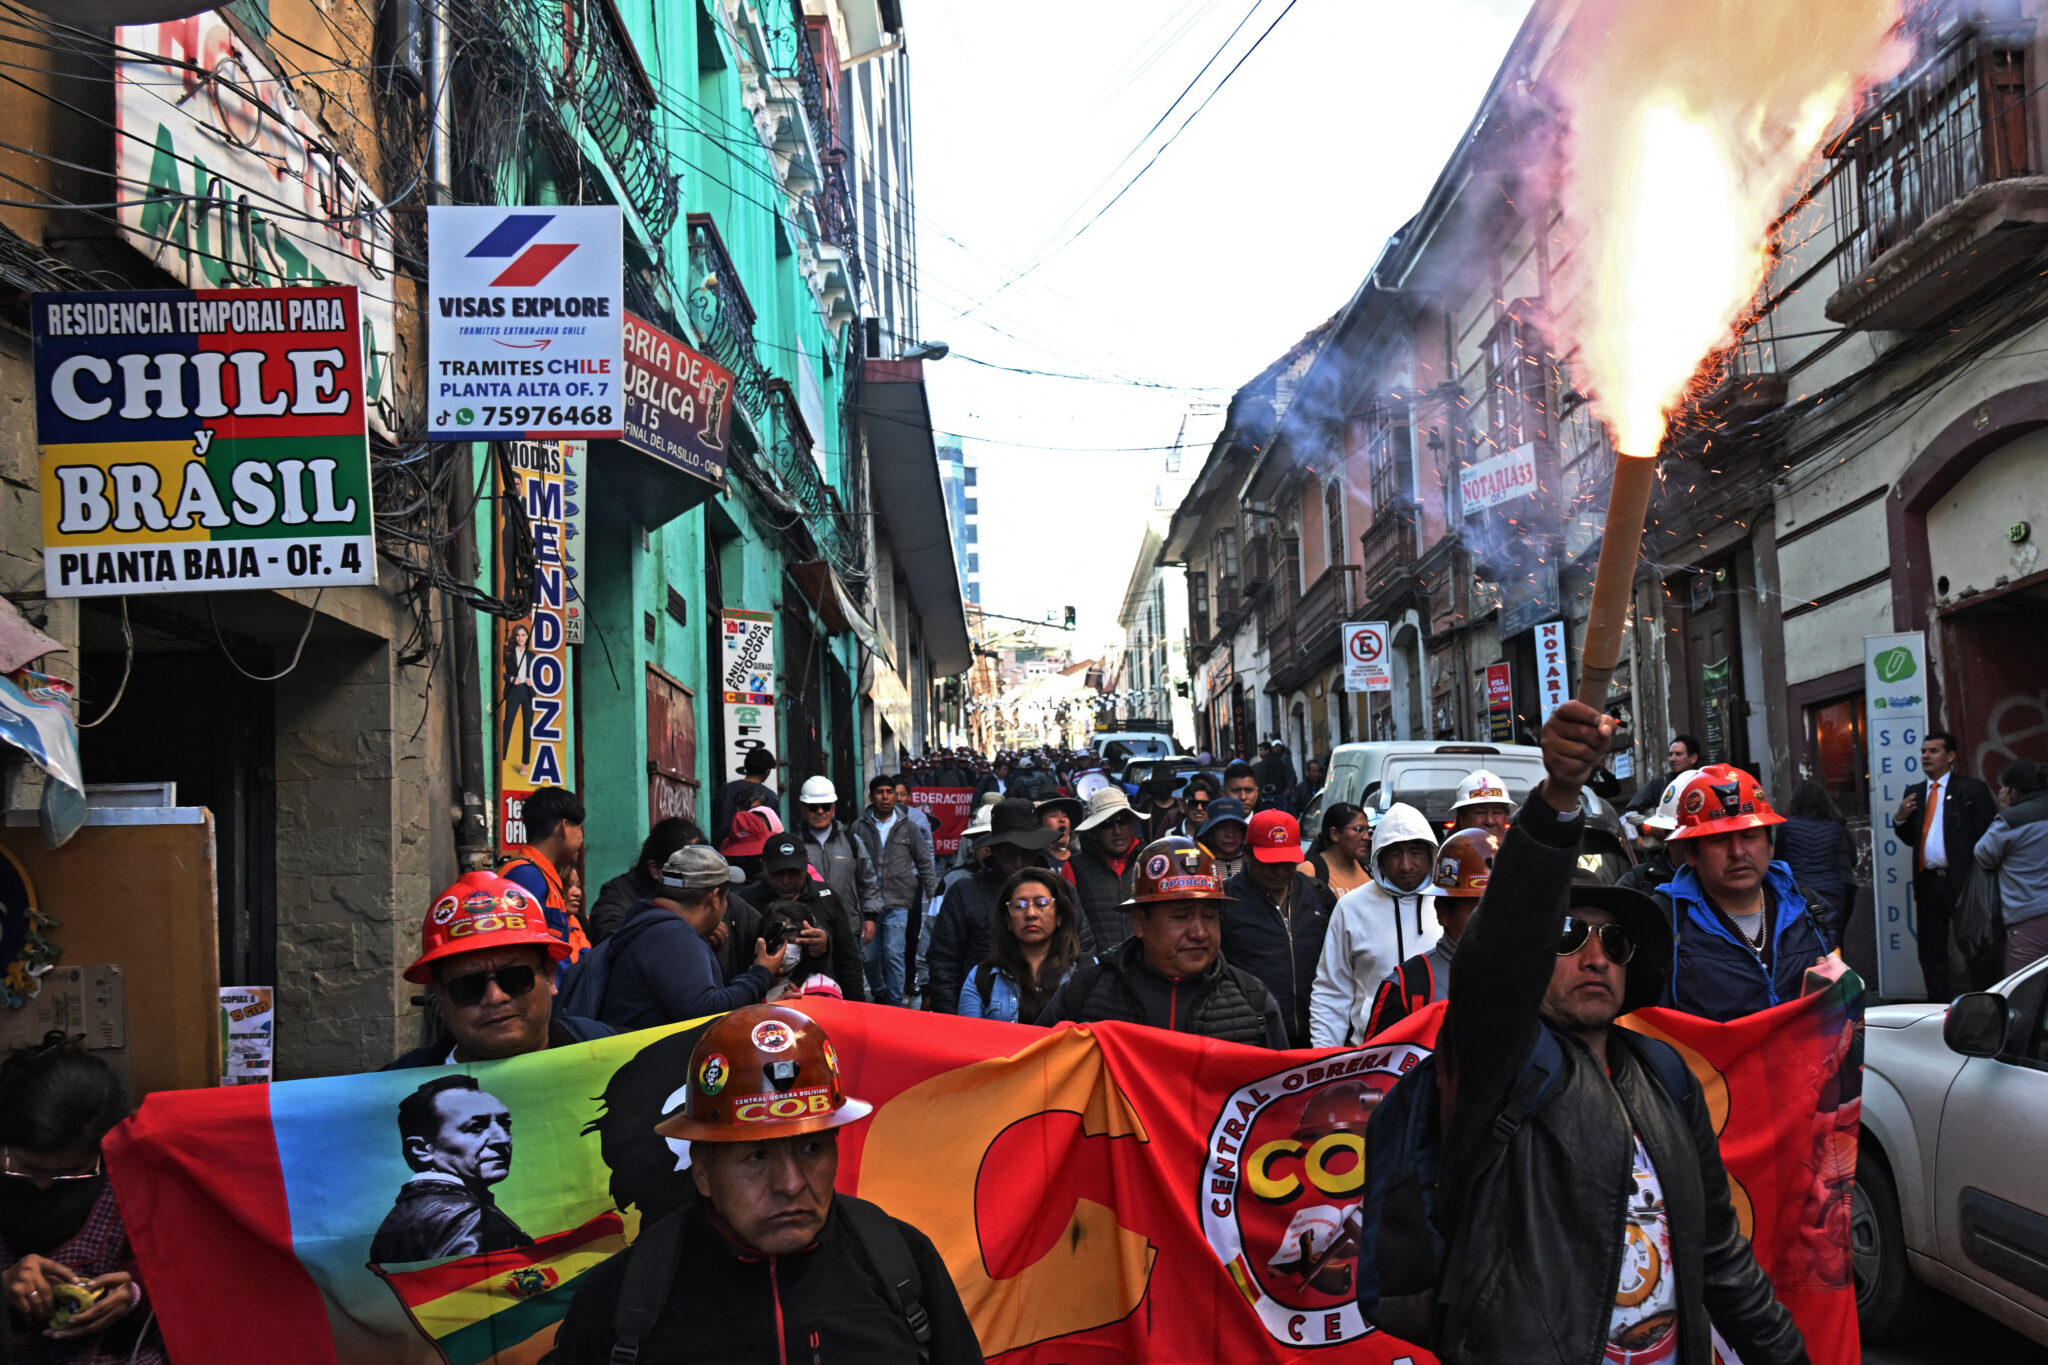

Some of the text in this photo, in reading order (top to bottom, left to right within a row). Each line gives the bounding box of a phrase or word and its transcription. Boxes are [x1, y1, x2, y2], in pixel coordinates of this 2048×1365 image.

[47, 298, 346, 336] RESIDENCIA TEMPORAL PARA
[438, 297, 610, 318] VISAS EXPLORE
[459, 326, 587, 336] TRAMITES EXTRANJERIA CHILE
[50, 348, 351, 421] CHILE
[439, 359, 611, 377] TRAMITES CHILE
[676, 350, 703, 389] DE
[440, 382, 609, 397] PLANTA ALTA OF. 7
[481, 405, 613, 426] 75976468
[641, 403, 660, 430] 15
[193, 429, 215, 455] y
[507, 441, 560, 475] MODAS
[625, 421, 648, 443] FINAL
[650, 435, 666, 451] DEL
[667, 442, 700, 467] PASILLO
[55, 457, 357, 534] BRASIL
[60, 548, 178, 586] PLANTA
[184, 546, 261, 581] BAJA
[286, 543, 332, 576] OF.
[340, 542, 362, 574] 4
[528, 478, 563, 785] MENDOZA
[725, 623, 762, 687] ANILLADOS
[731, 625, 773, 691] FOTOCOPIA
[1541, 624, 1561, 708] NOTARI
[725, 692, 774, 705] COLOR
[912, 791, 973, 804] EDERACION
[1880, 729, 1898, 884] SELLOS
[450, 915, 528, 937] COB
[221, 995, 256, 1004] COPIAS A
[735, 1096, 767, 1105] CENTRAL
[769, 1092, 798, 1101] OBRERA
[736, 1094, 831, 1122] COB
[1211, 1087, 1271, 1219] CENTRAL
[1282, 1050, 1393, 1091] OBRERA
[1247, 1132, 1367, 1204] CO
